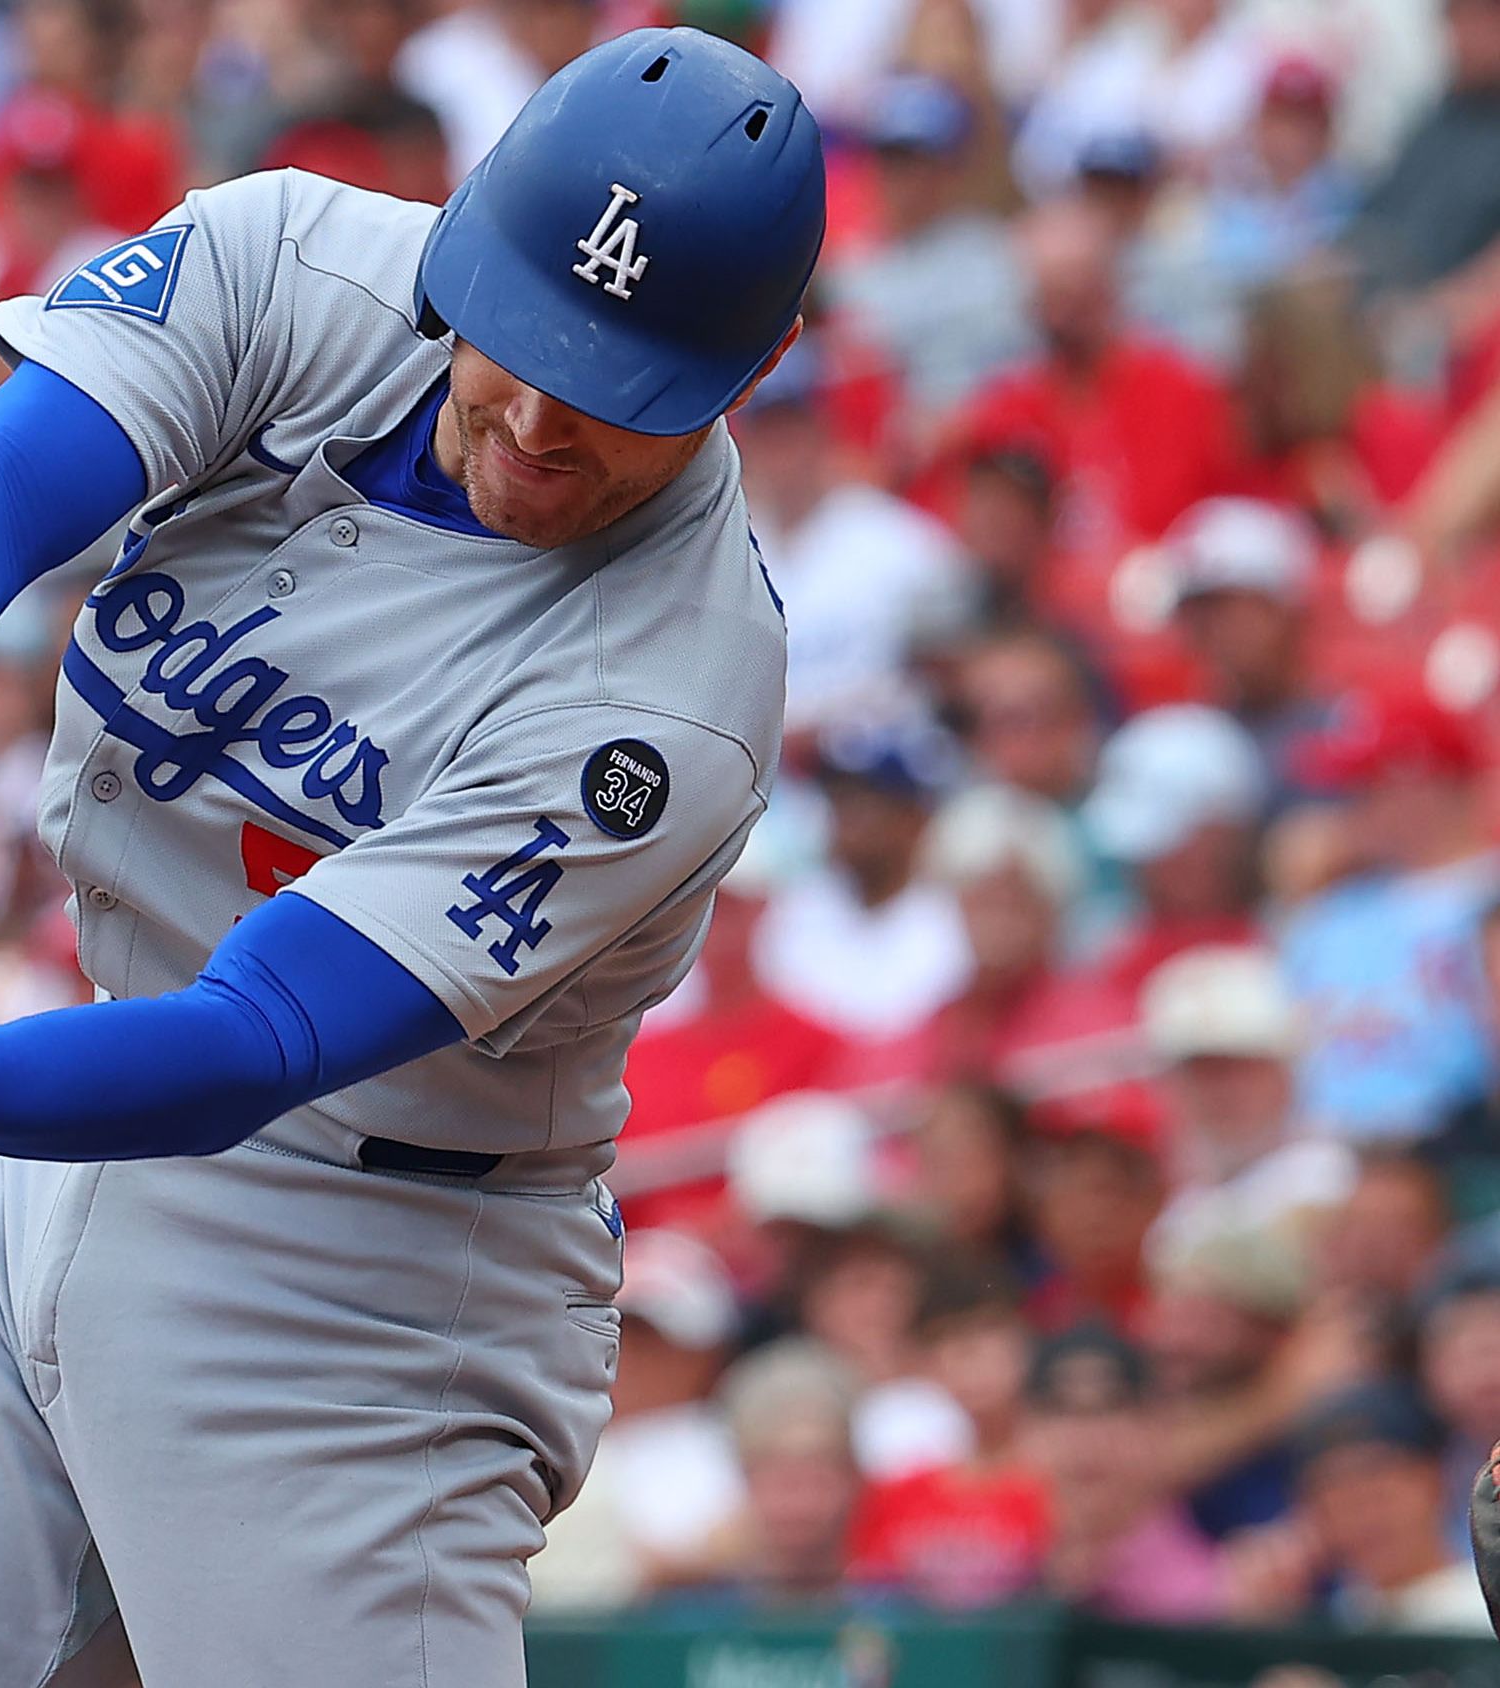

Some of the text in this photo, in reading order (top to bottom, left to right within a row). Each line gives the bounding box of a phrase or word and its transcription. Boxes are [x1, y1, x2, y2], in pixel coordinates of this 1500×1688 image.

[100, 244, 164, 288] G
[572, 183, 649, 300] LA
[83, 490, 390, 830] odgers
[595, 768, 652, 827] 34
[609, 749, 661, 787] FERNANDO
[445, 814, 571, 977] LA
